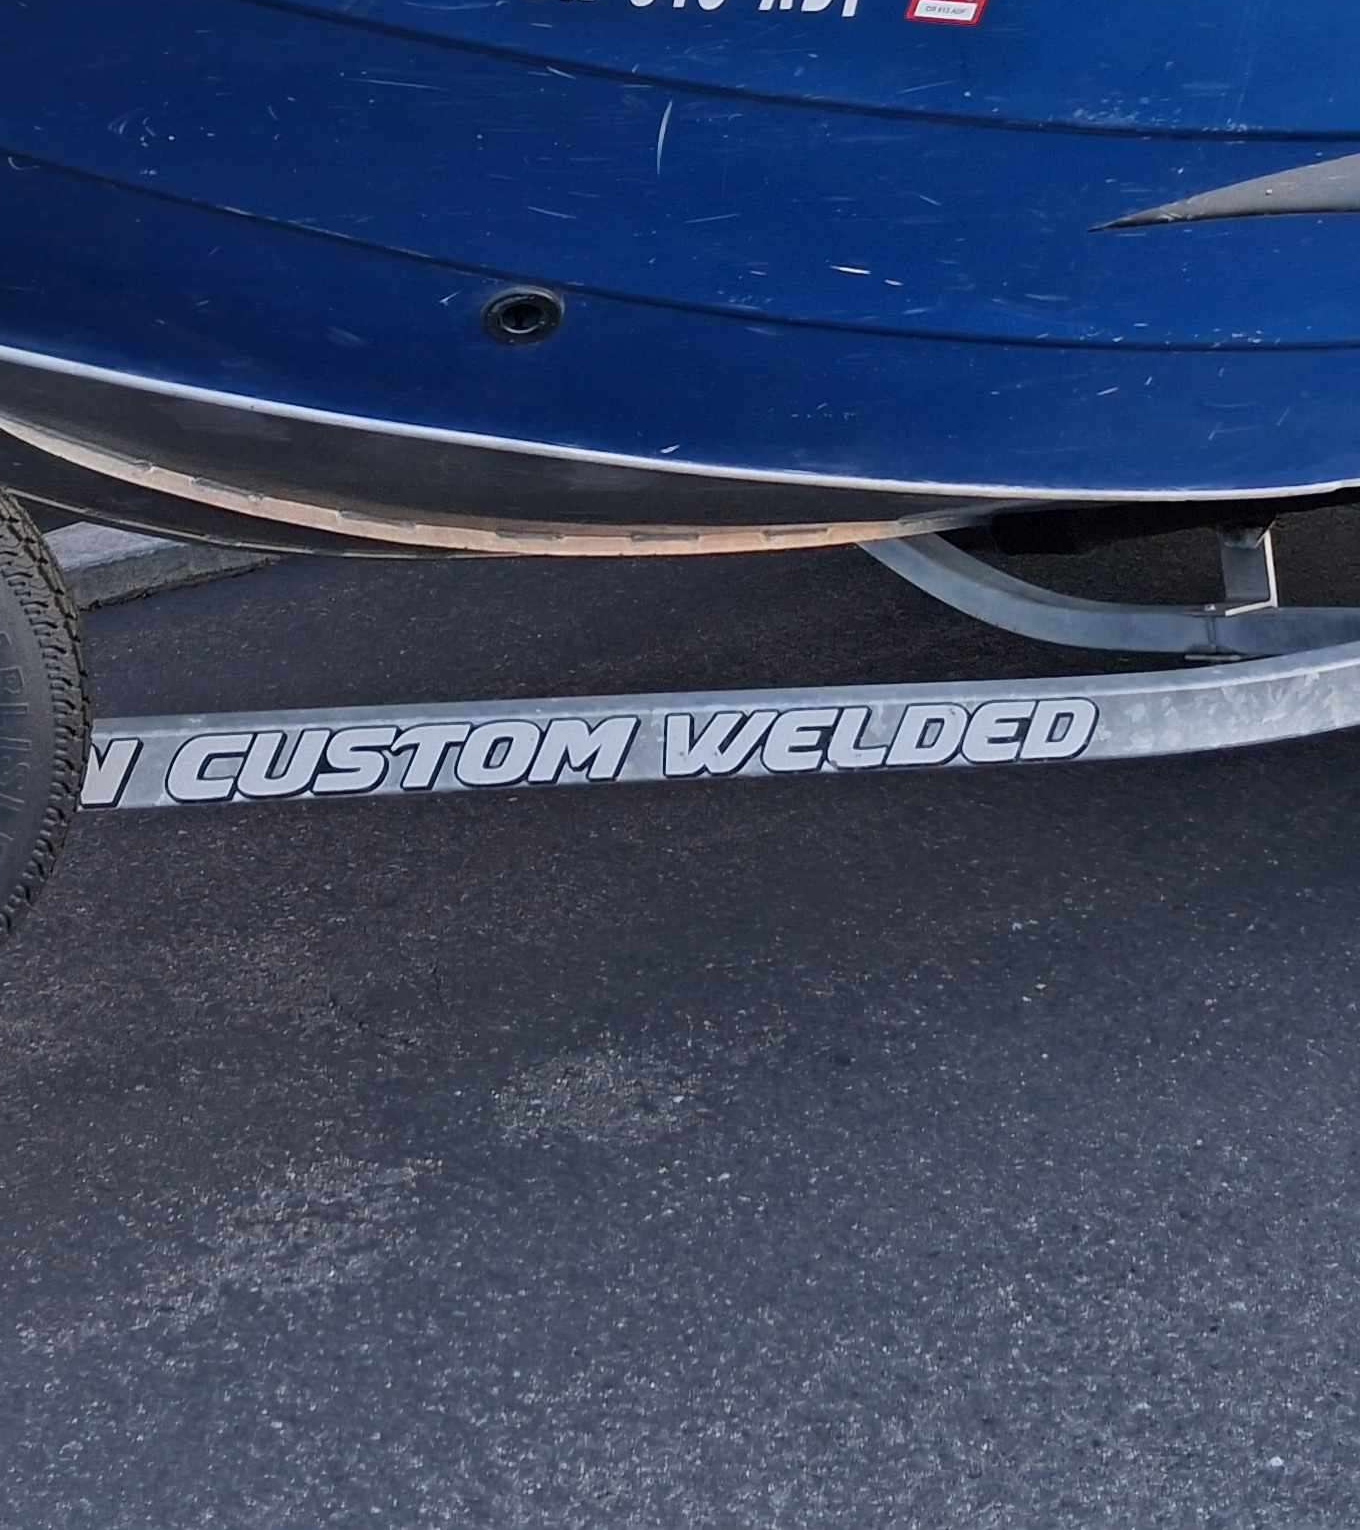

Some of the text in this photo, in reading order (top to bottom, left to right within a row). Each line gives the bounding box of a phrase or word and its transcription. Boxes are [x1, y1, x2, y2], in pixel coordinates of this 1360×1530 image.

[80, 696, 1101, 808] N CUSTOM WELDED
